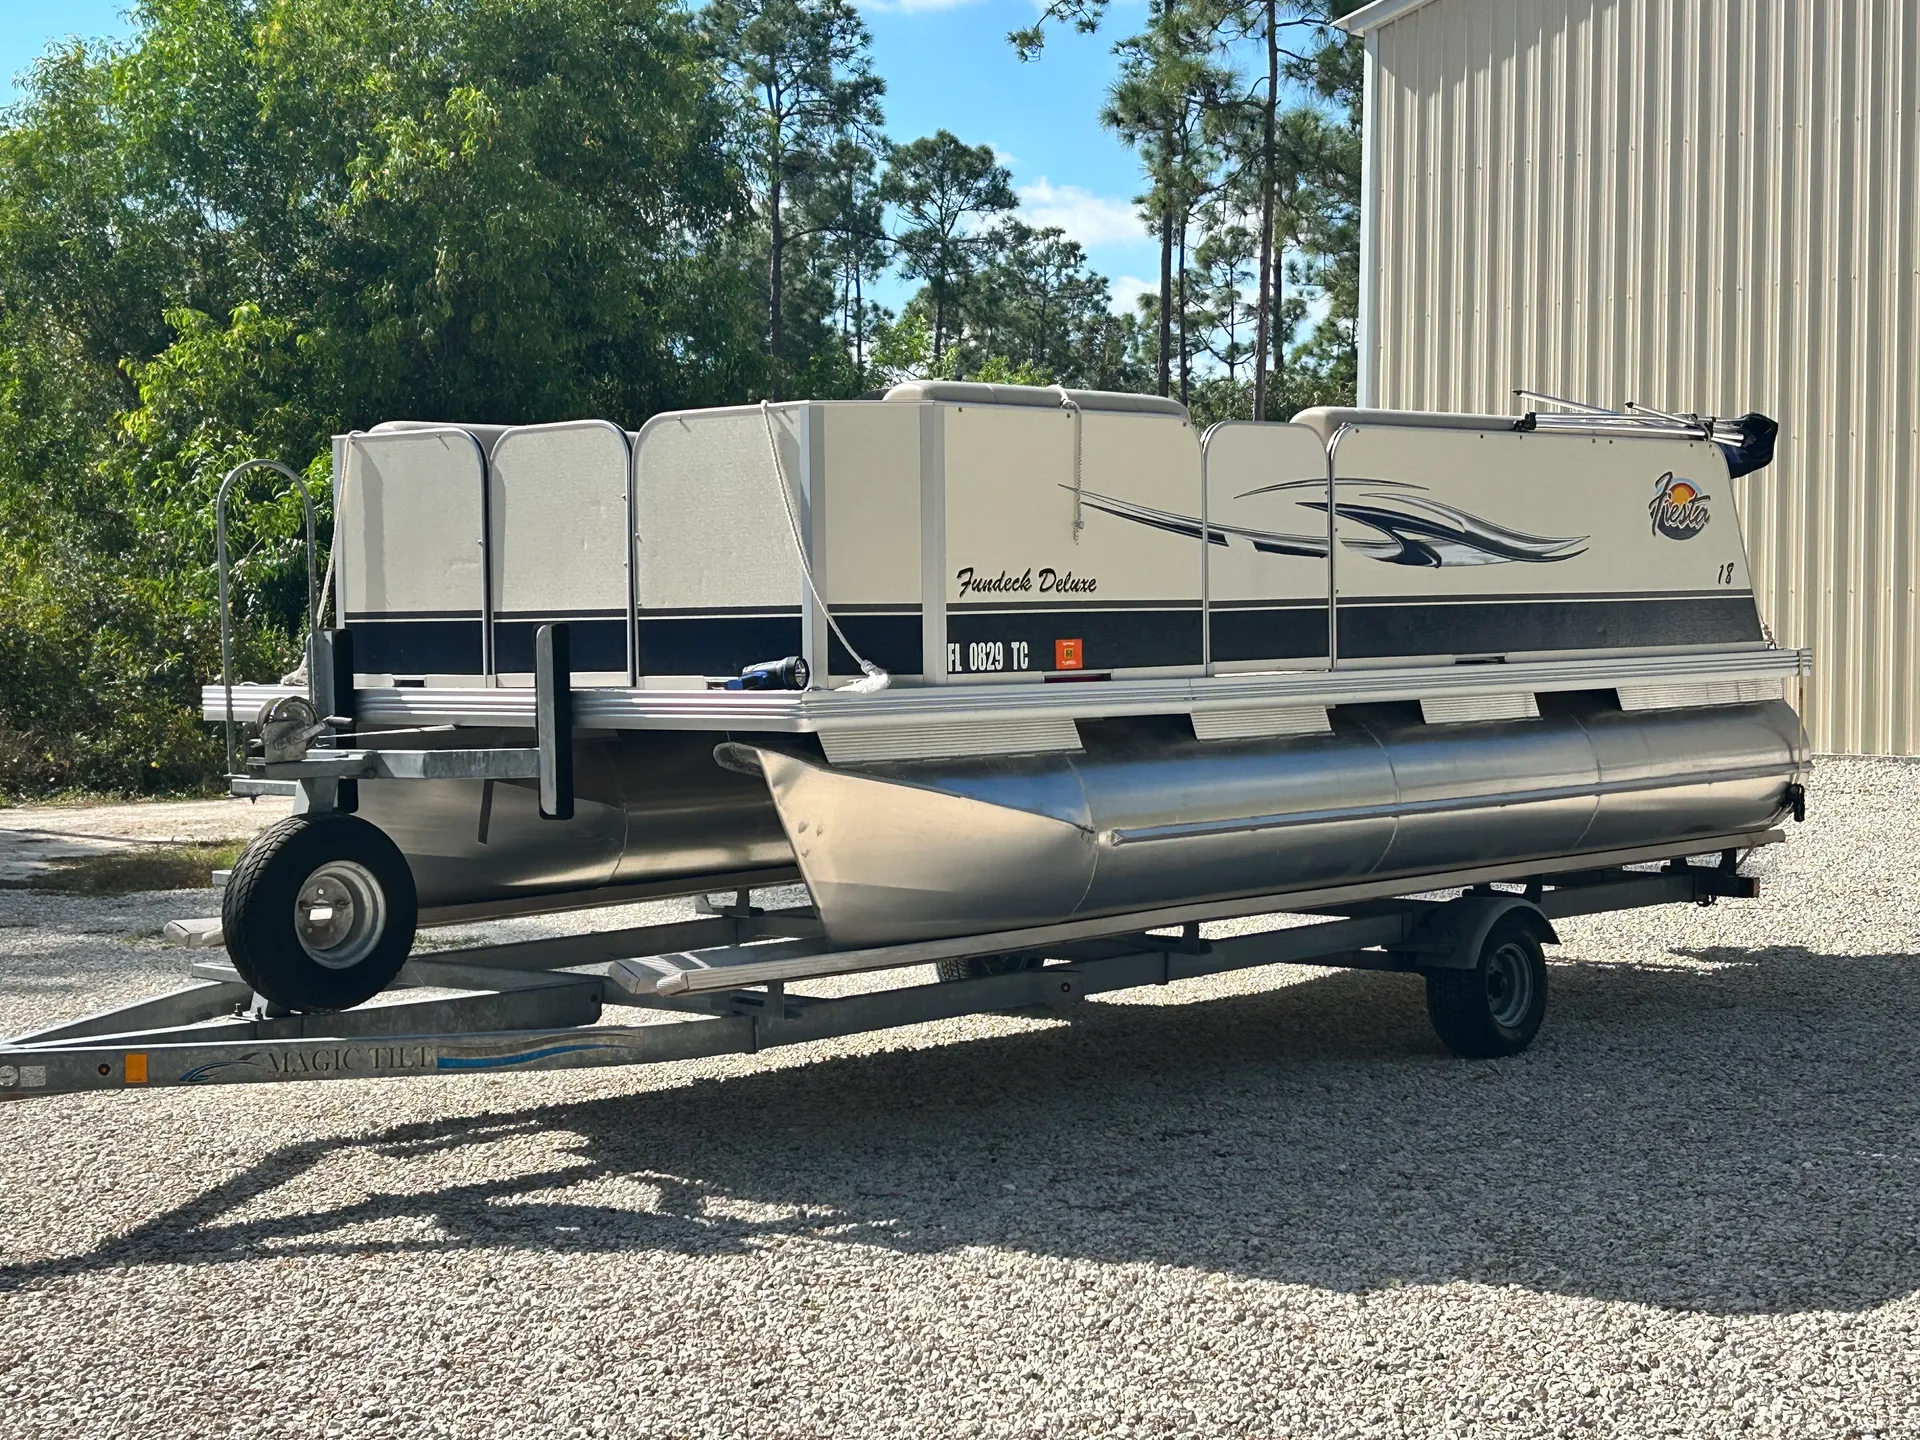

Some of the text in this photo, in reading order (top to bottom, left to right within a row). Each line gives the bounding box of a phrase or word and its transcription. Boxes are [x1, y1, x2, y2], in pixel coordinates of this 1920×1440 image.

[1648, 471, 1711, 537] Fiesta
[956, 567, 1098, 598] Fundeck Deluxe
[1717, 562, 1735, 584] 18
[947, 641, 1029, 672] FL 0829 TC
[268, 1045, 432, 1073] MAGIC TILT
